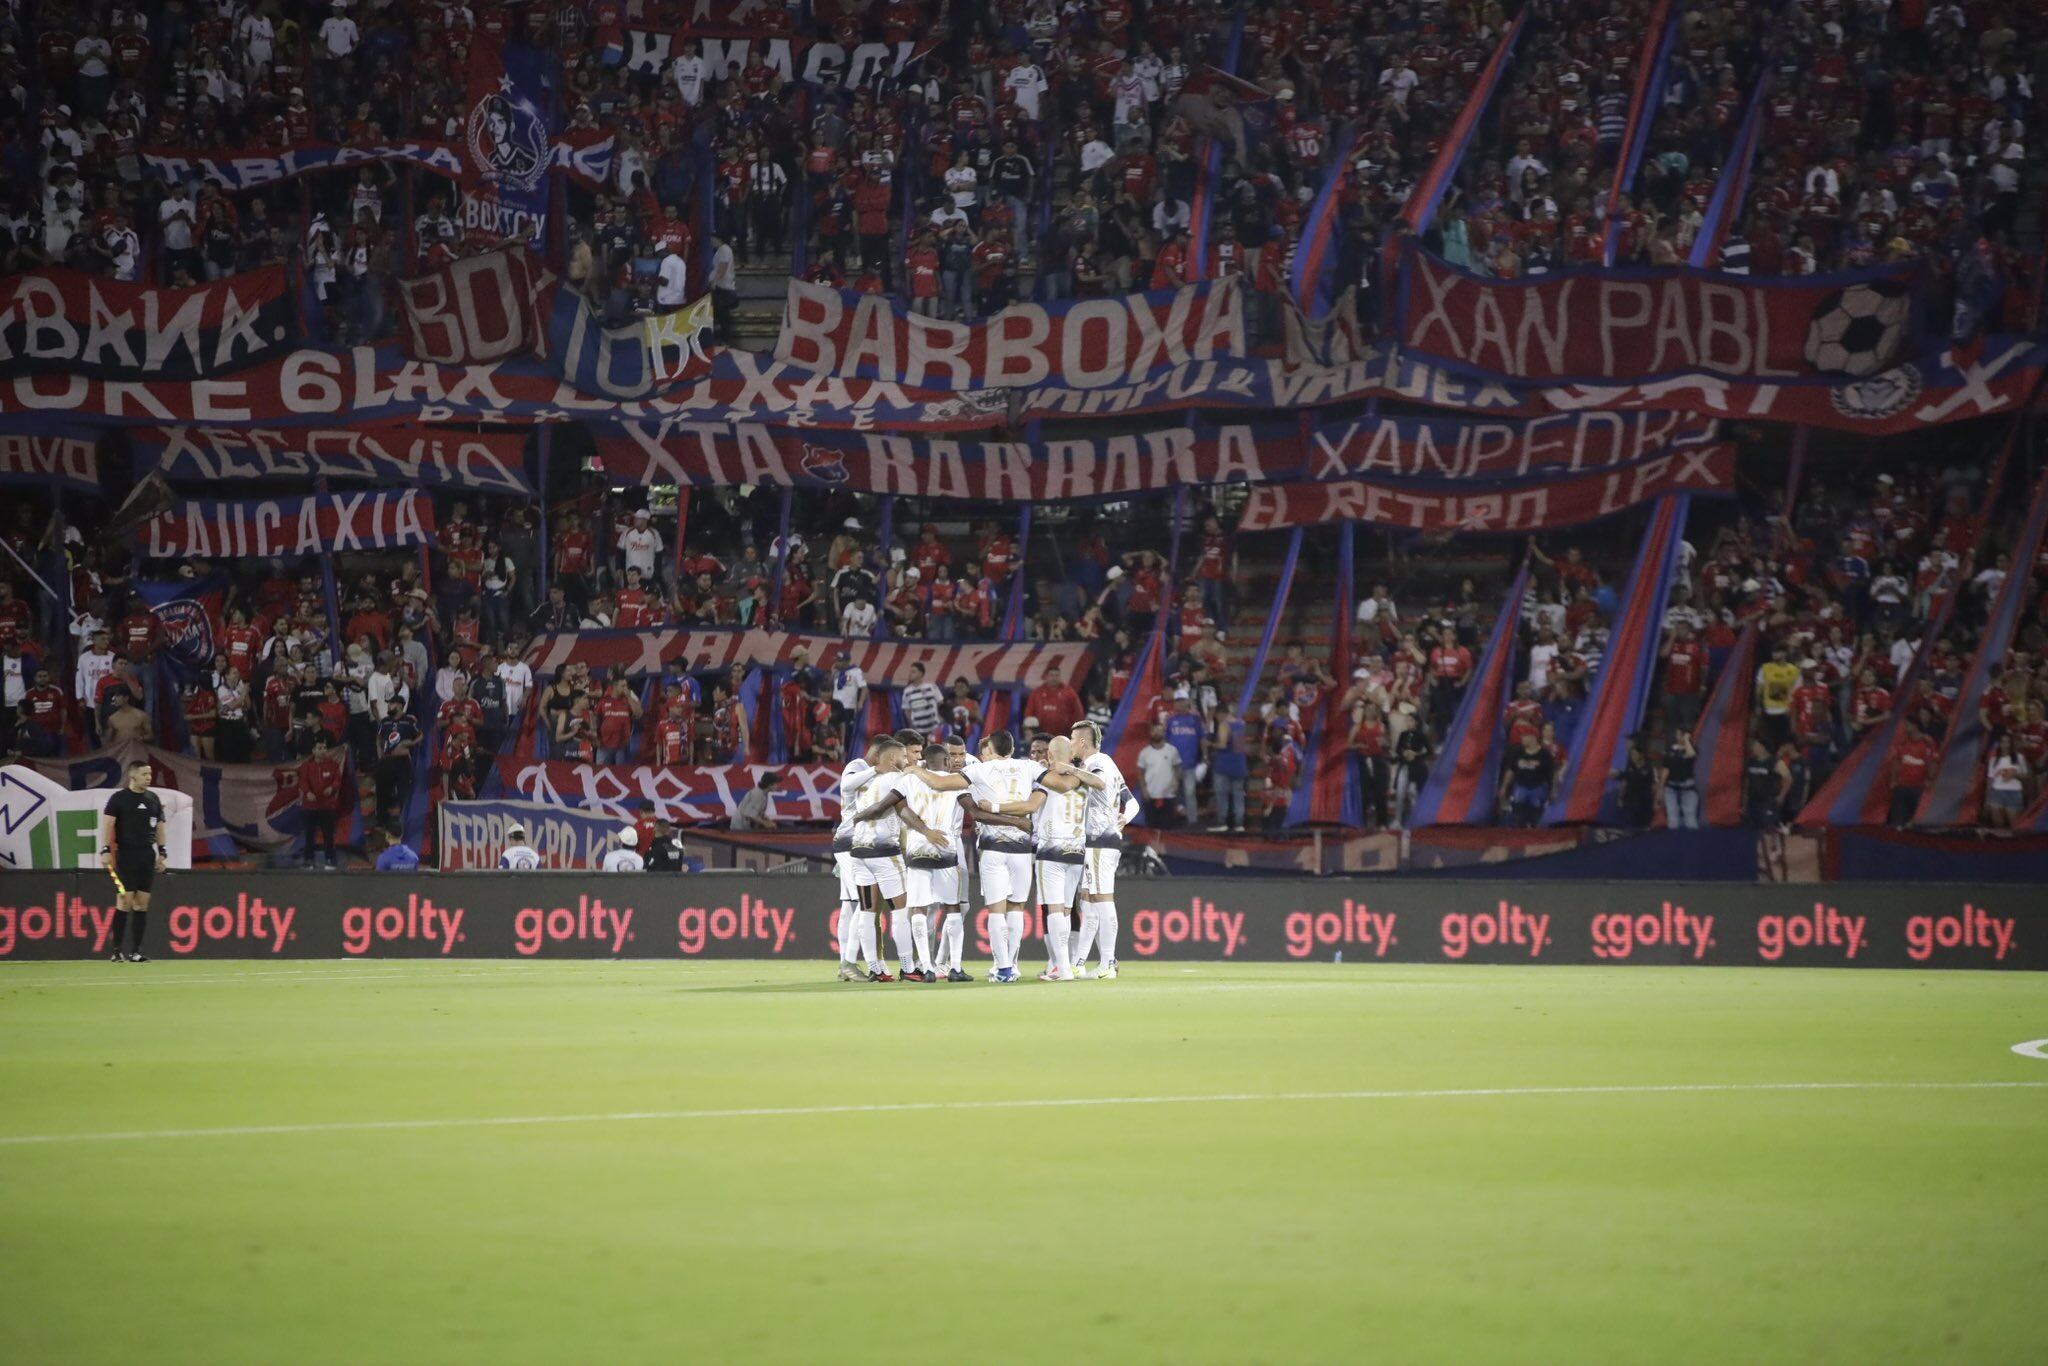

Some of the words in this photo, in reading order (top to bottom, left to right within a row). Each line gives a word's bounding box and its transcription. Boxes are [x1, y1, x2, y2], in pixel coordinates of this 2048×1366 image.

[773, 274, 1247, 391] BARBOXA
[169, 892, 296, 953] golty
[342, 893, 465, 954] golty
[514, 894, 634, 955] golty
[678, 894, 795, 954] golty
[1132, 897, 1246, 955] golty
[1285, 899, 1397, 958] golty
[1441, 901, 1551, 958] golty
[1756, 903, 1866, 961] golty
[1906, 904, 2015, 960] golty
